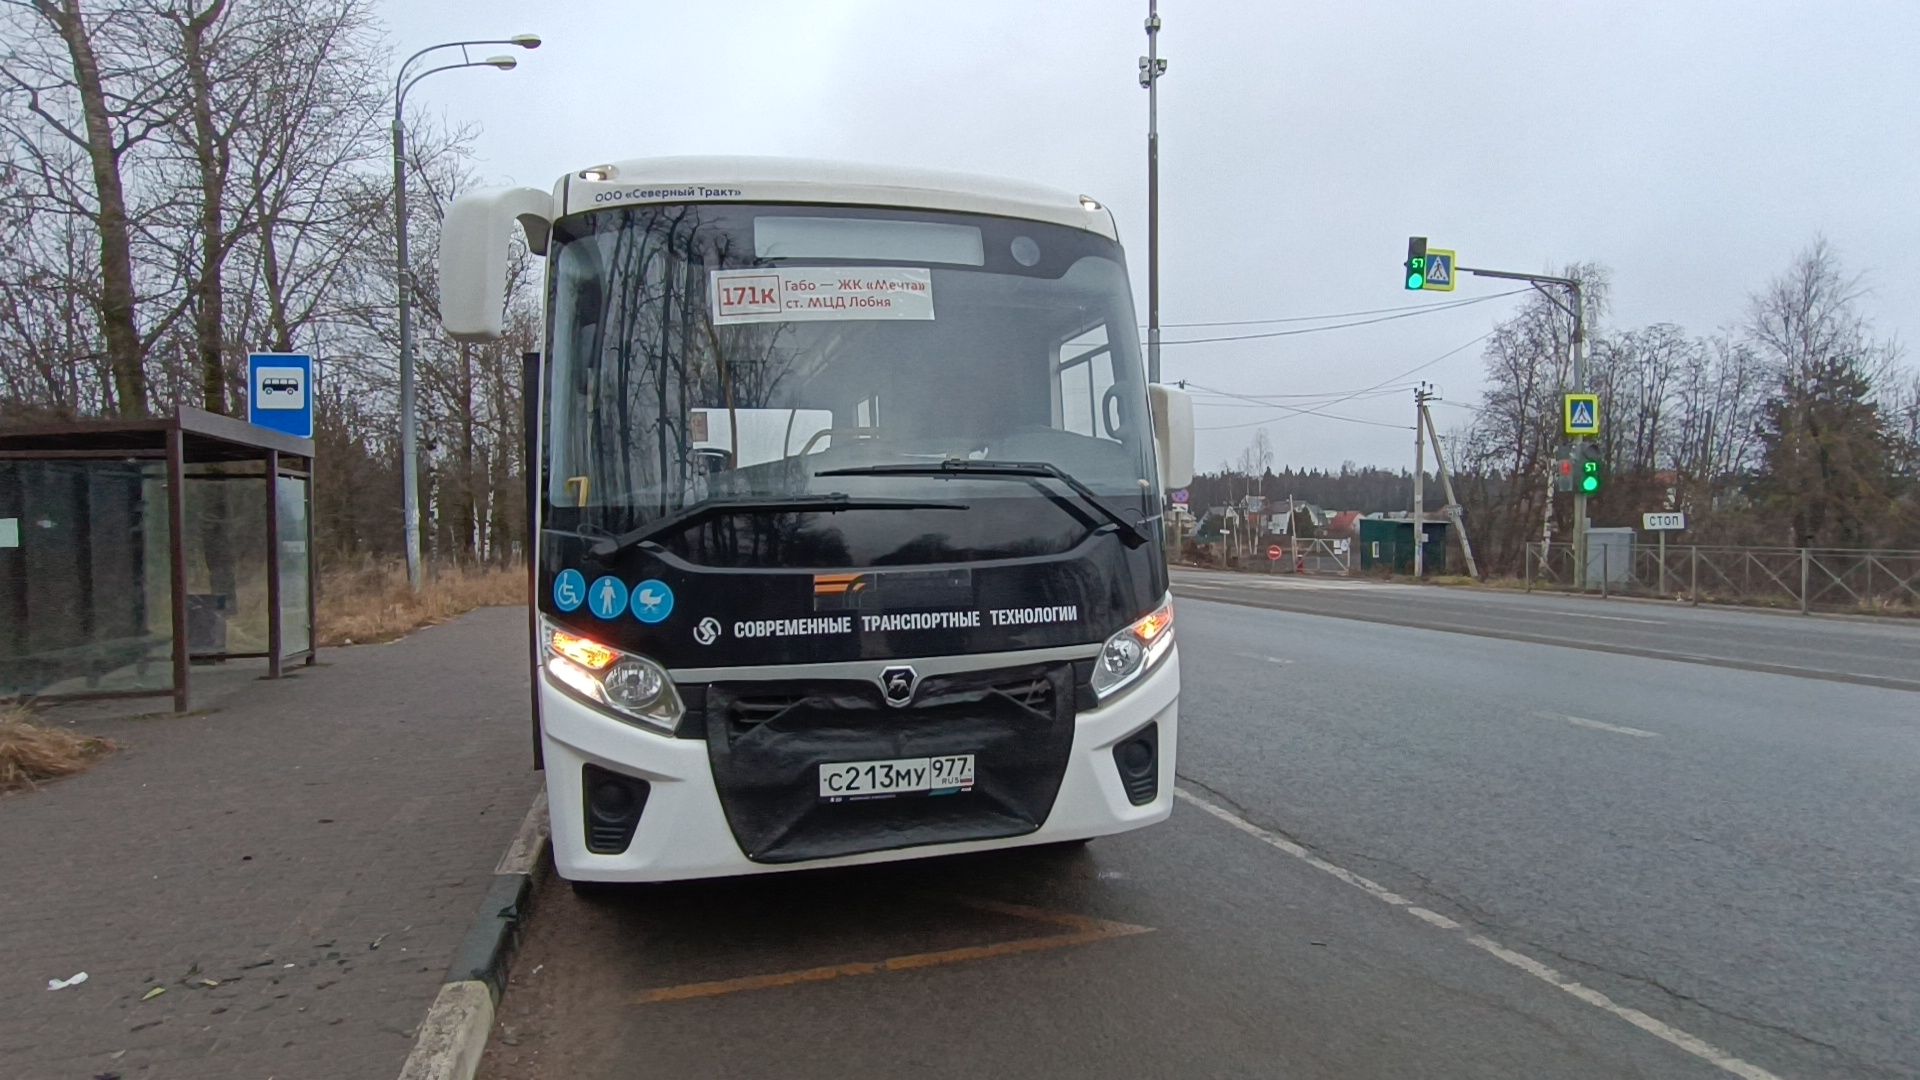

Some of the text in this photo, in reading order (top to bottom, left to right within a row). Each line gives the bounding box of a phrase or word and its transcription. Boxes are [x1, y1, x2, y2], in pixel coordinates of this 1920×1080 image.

[595, 186, 741, 203] ООО «Северный Тракт»
[785, 279, 817, 292] Габо
[838, 278, 863, 290] ЖК
[866, 279, 926, 291] «Мечта»
[786, 296, 892, 310] ст. МЦД Лобня
[1649, 515, 1679, 527] СТОП
[734, 605, 1078, 638] СОВРЕМЕННЫЕ ТРАНСПОРТНЫЕ ТЕХНОЛОГИИ
[932, 757, 969, 778] 977
[941, 777, 960, 785] RUS
